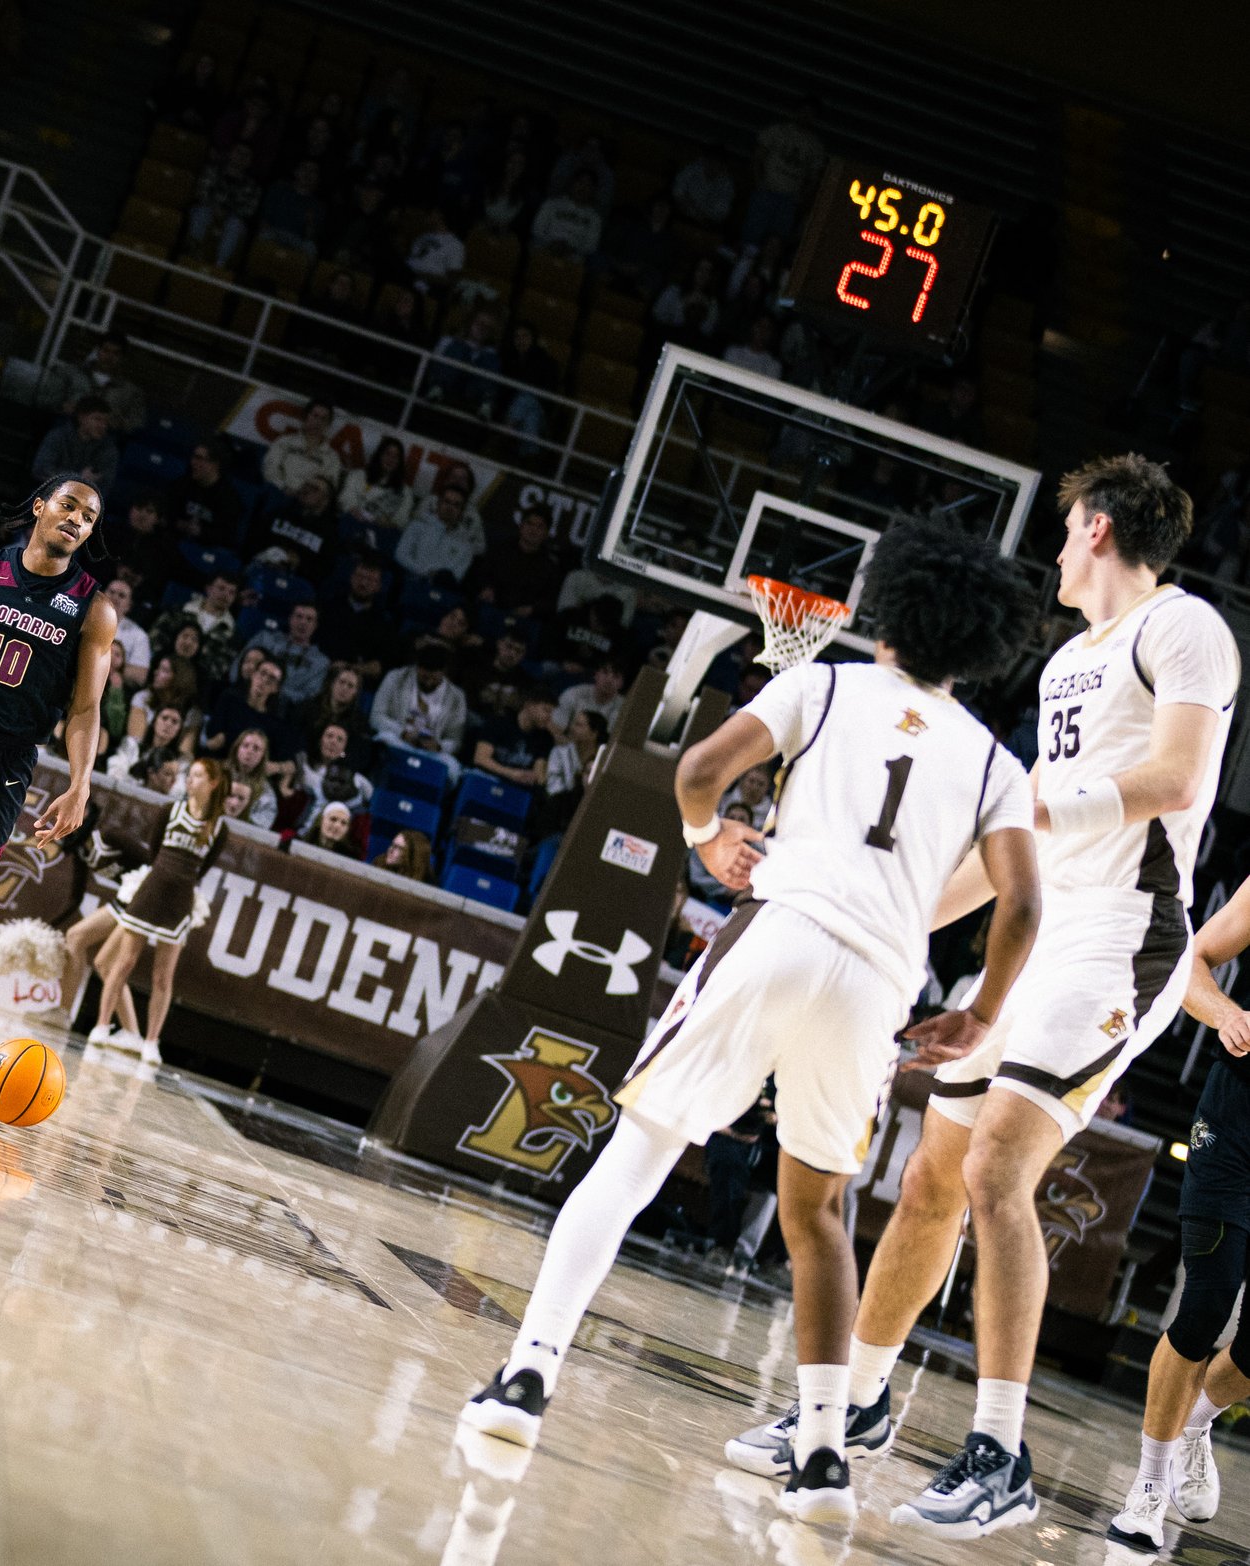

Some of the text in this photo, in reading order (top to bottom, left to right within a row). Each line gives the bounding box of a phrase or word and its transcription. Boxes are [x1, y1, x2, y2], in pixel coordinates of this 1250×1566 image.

[849, 179, 946, 247] 45.0
[882, 170, 954, 205] DAKTRONICS
[836, 229, 939, 323] 27
[1048, 705, 1083, 762] 35
[865, 754, 913, 853] 1
